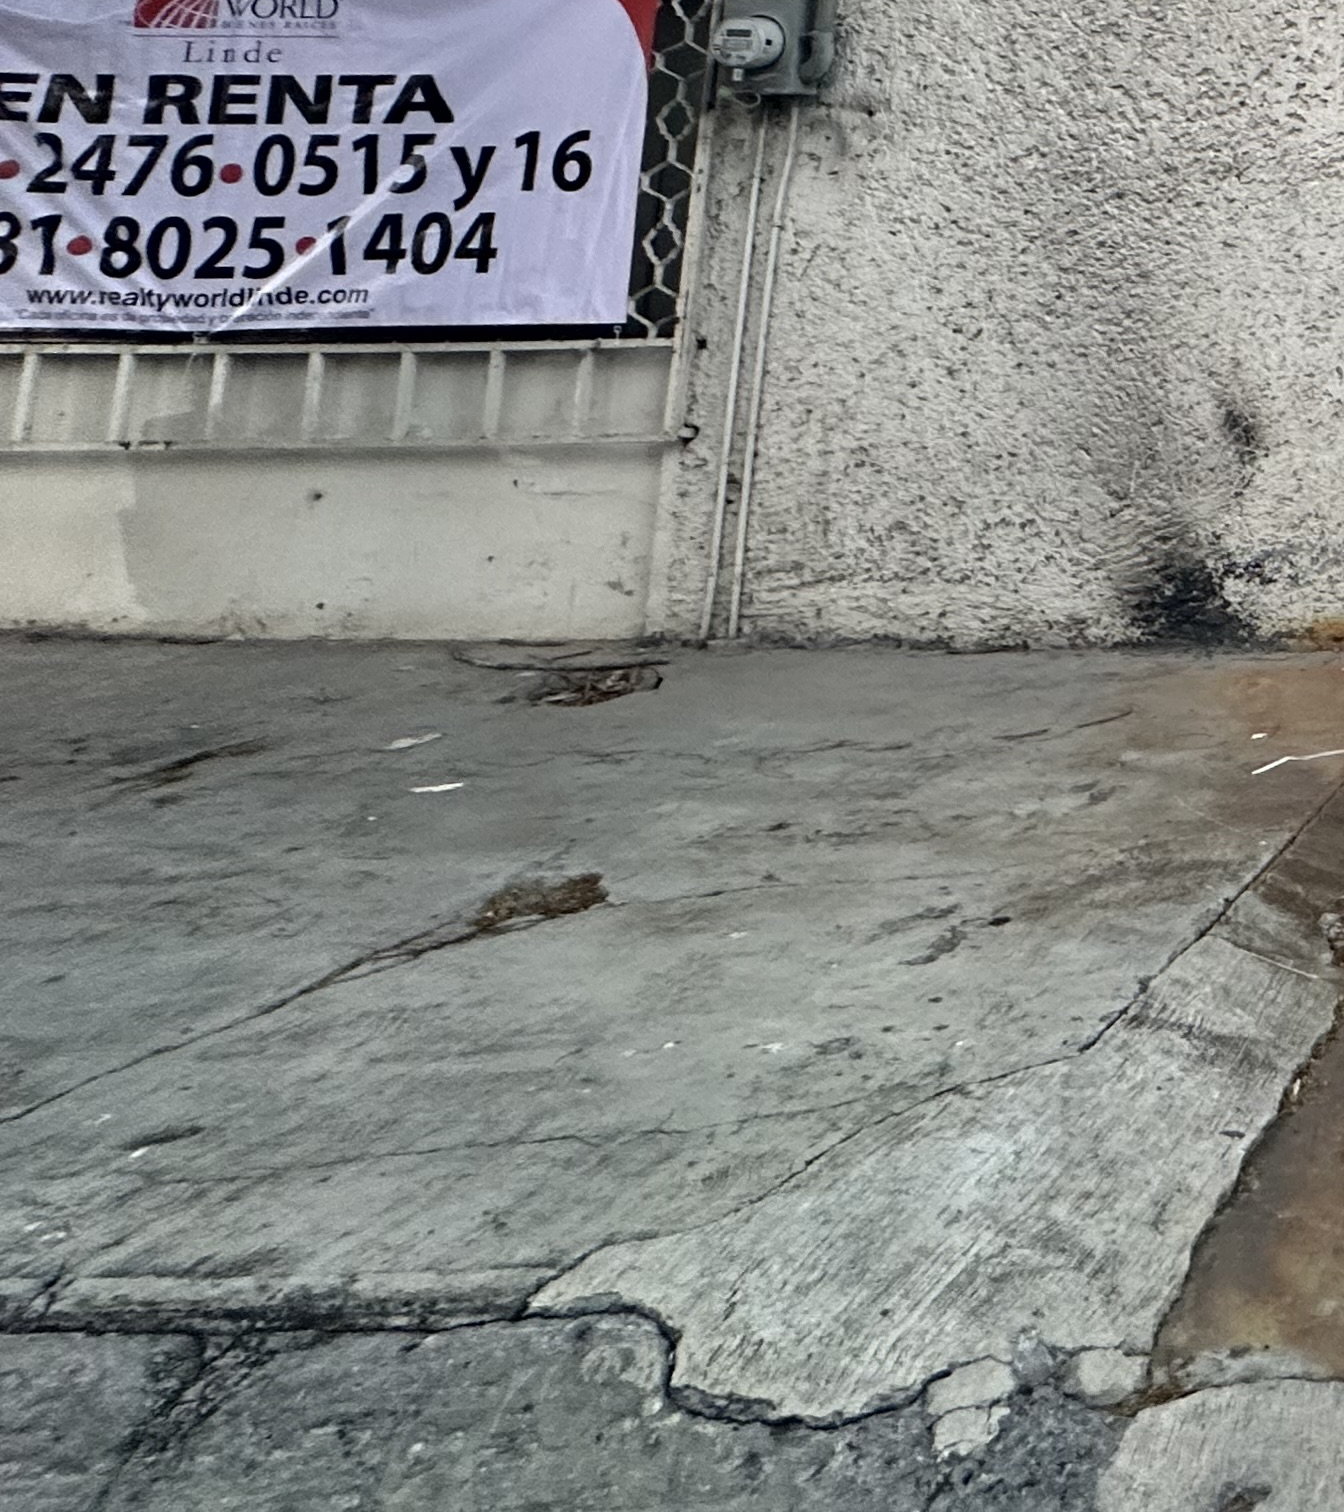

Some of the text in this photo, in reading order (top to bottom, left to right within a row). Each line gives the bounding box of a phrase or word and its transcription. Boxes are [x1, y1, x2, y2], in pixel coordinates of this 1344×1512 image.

[182, 40, 283, 64] Linde
[0, 72, 455, 125] EN RENTA
[450, 145, 497, 211] y
[514, 129, 593, 193] 16
[27, 286, 370, 312] www.realtyworldlnde.com
